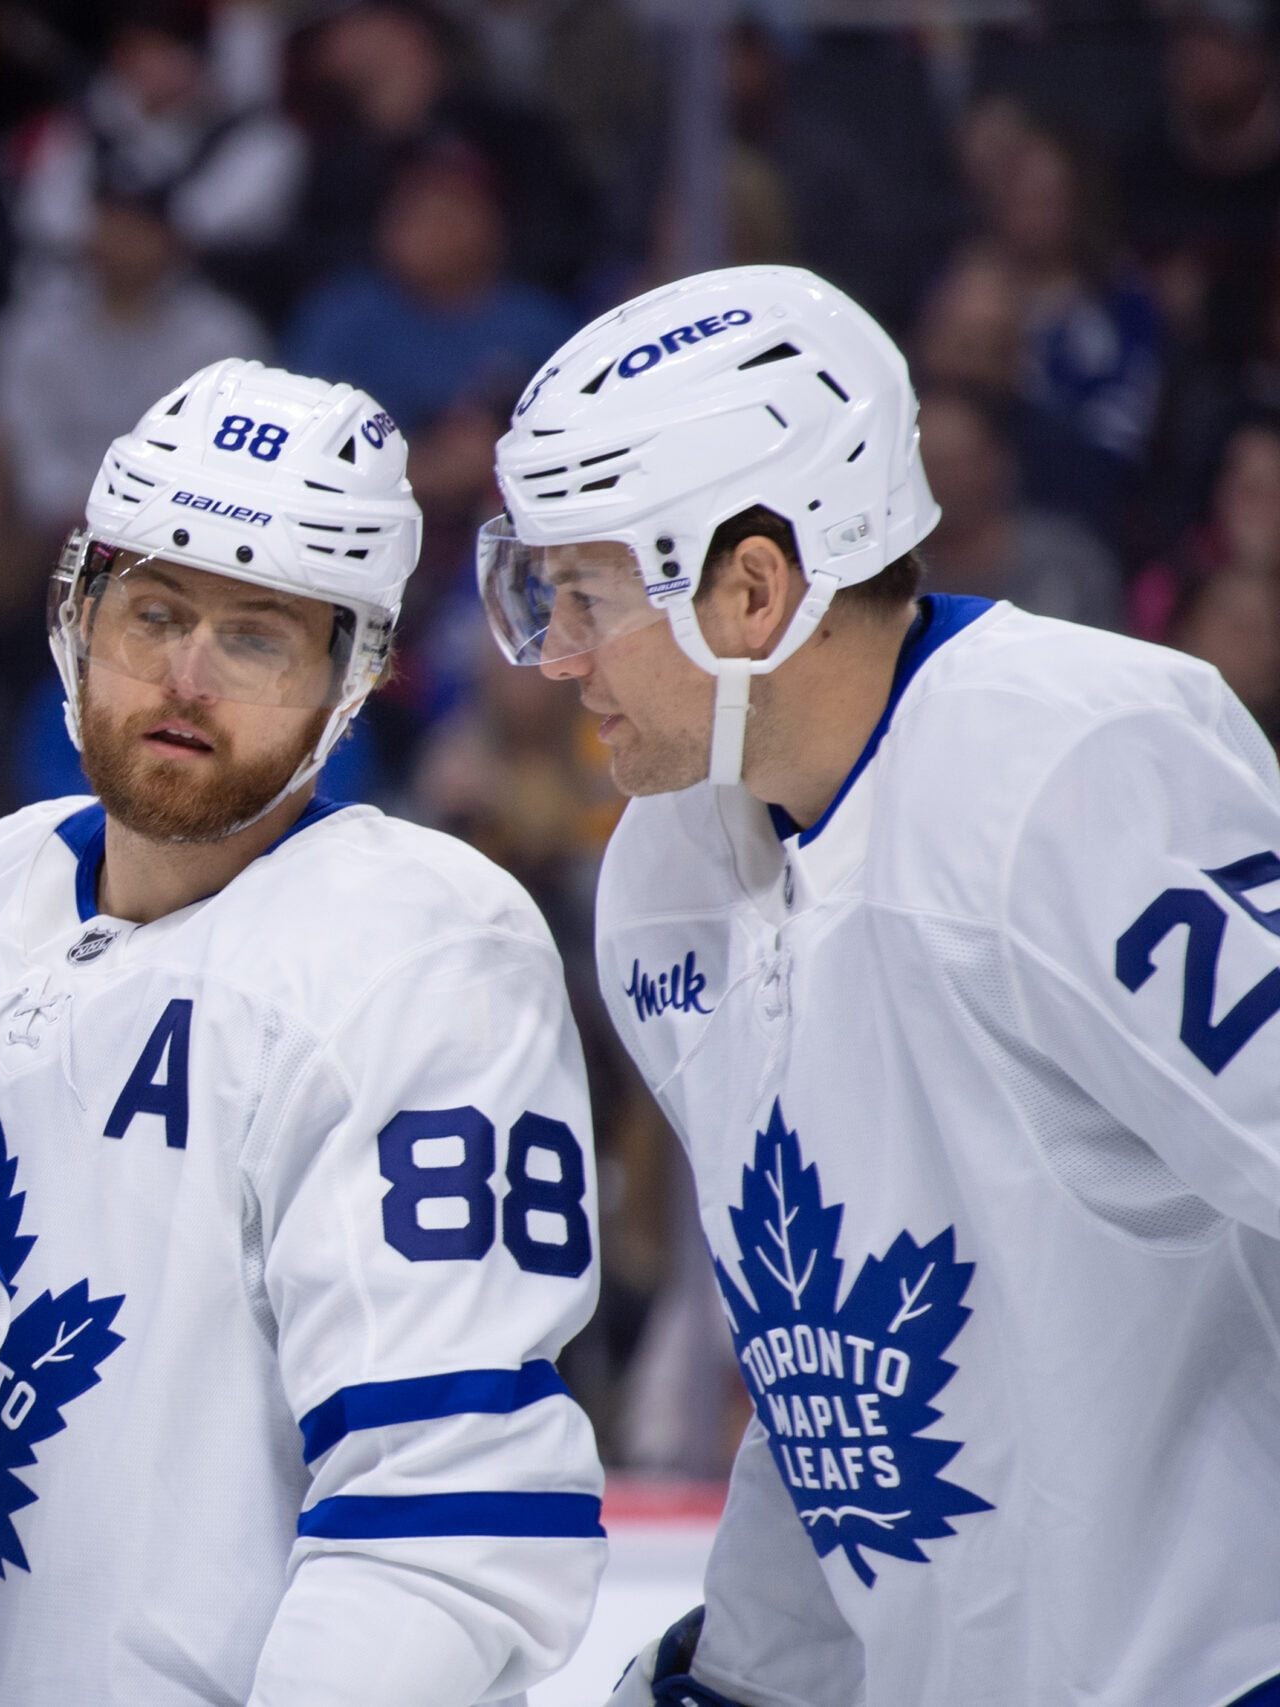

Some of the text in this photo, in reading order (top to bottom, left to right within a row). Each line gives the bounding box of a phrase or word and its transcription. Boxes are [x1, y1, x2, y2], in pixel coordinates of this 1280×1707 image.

[618, 308, 753, 379] OREO
[213, 414, 289, 463] 88
[361, 412, 397, 450] ORE
[102, 998, 194, 1150] A
[377, 1105, 593, 1279] 88
[742, 1324, 911, 1398] TORONTO
[765, 1391, 888, 1438] MAPLE
[781, 1443, 901, 1491] LEAFS
